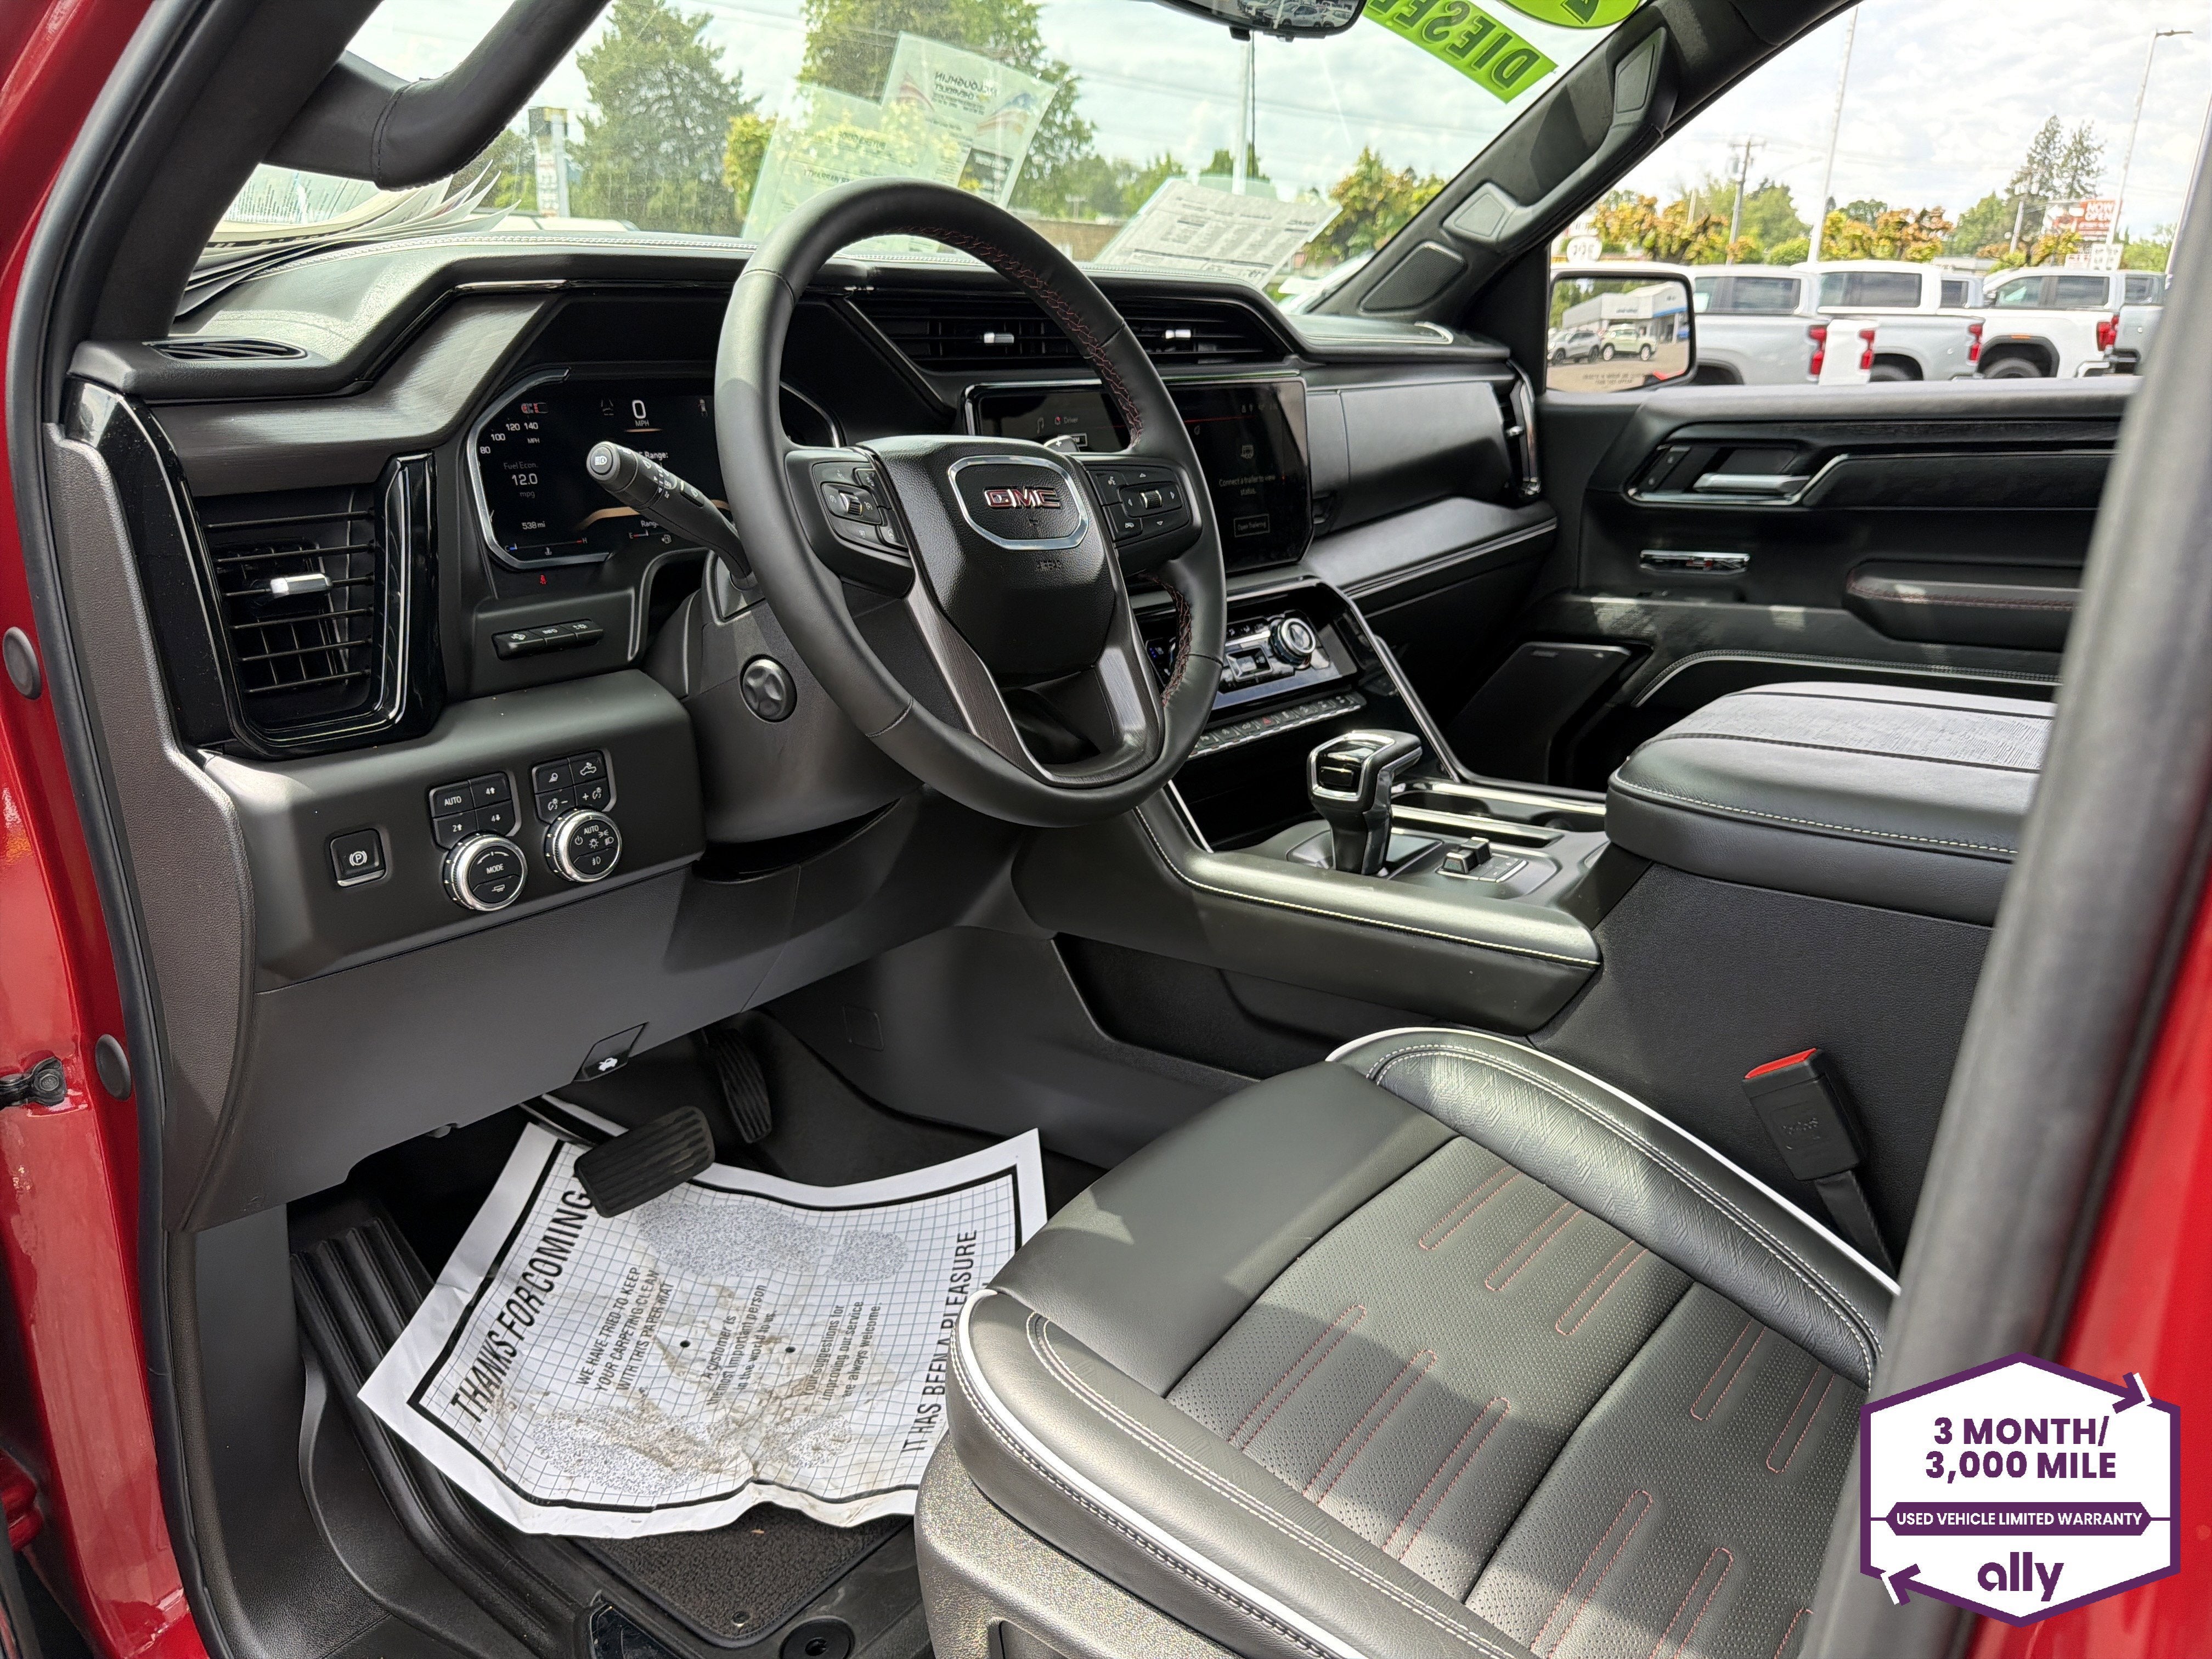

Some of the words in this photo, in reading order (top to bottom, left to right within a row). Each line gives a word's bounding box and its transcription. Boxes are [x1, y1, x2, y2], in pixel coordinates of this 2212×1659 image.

[632, 399, 646, 419] 0
[635, 419, 650, 427] MPH
[490, 433, 506, 441] 100
[479, 446, 491, 454] 80
[645, 451, 669, 461] Range:
[503, 462, 518, 470] Fuel
[511, 473, 538, 486] 12.0
[1218, 478, 1240, 487] Connect
[984, 488, 1062, 508] GMC
[522, 522, 537, 530] 538
[444, 795, 462, 806] AUTO
[584, 825, 599, 834] AUTO
[487, 864, 504, 874] MODE
[620, 1267, 641, 1295] KEEP
[450, 1330, 517, 1423] THANKS
[496, 1285, 545, 1341] FOR
[522, 1190, 594, 1293] COMING
[613, 1297, 629, 1310] TO
[599, 1311, 622, 1338] TRIED
[723, 1315, 737, 1325] is
[844, 1301, 864, 1335] service
[594, 1361, 619, 1391] YOUR
[610, 1307, 644, 1361] CARPETING
[636, 1269, 659, 1305] CLEAN
[616, 1364, 639, 1390] WITH
[631, 1340, 650, 1362] THIS
[641, 1306, 664, 1338] PAPER
[656, 1280, 674, 1305] MAT
[756, 1324, 771, 1334] to
[716, 1369, 735, 1392] most
[728, 1321, 754, 1368] important
[746, 1285, 768, 1321] person
[839, 1336, 853, 1353] our
[585, 1338, 609, 1366] HAVE
[748, 1333, 766, 1363] world
[802, 1374, 819, 1396] Your
[812, 1319, 840, 1374] suggestions
[830, 1305, 845, 1318] for
[739, 1364, 755, 1380] the
[847, 1349, 869, 1381] always
[576, 1366, 595, 1385] WE
[819, 1355, 850, 1401] improving
[922, 1353, 947, 1395] BEEN
[842, 1383, 856, 1398] are
[909, 1403, 941, 1434] HAS
[901, 1438, 928, 1453] IT
